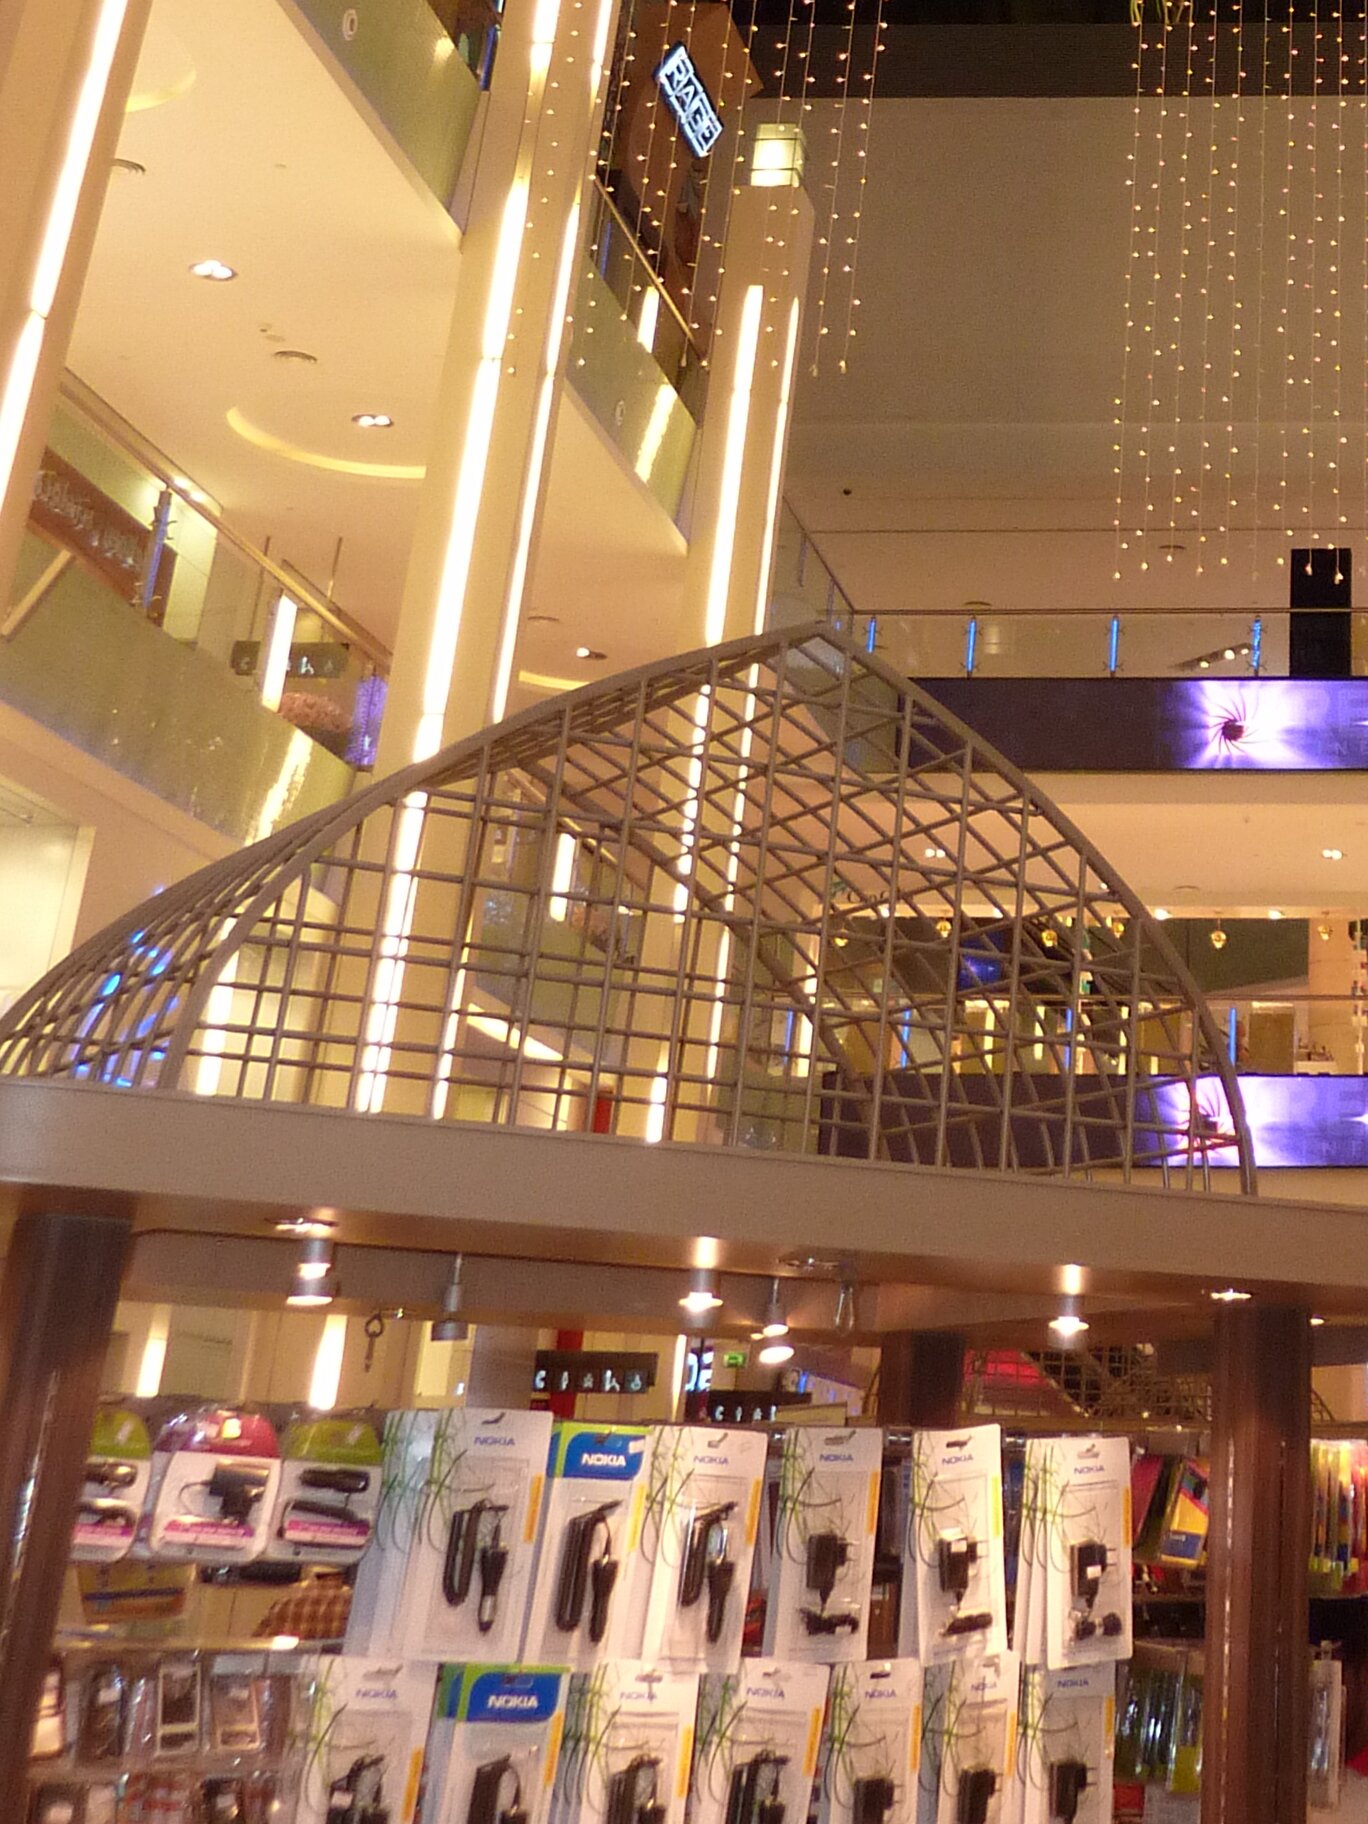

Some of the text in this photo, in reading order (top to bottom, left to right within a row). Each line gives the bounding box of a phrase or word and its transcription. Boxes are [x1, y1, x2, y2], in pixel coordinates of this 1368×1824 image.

[473, 1435, 516, 1448] NOKIA
[580, 1452, 627, 1468] NOKIA
[692, 1454, 730, 1466] NOKIA
[819, 1452, 854, 1463] NOKIA
[942, 1454, 975, 1466] NOKIA
[1073, 1463, 1106, 1475] NOKIA
[970, 1679, 998, 1693] NOKIA
[1056, 1678, 1090, 1689] NOKIA
[355, 1688, 399, 1701] NOKIA
[619, 1691, 658, 1702] NOKIA
[746, 1686, 786, 1700] NOKIA
[864, 1688, 898, 1699] NOKIA
[487, 1694, 540, 1710] NOKIA
